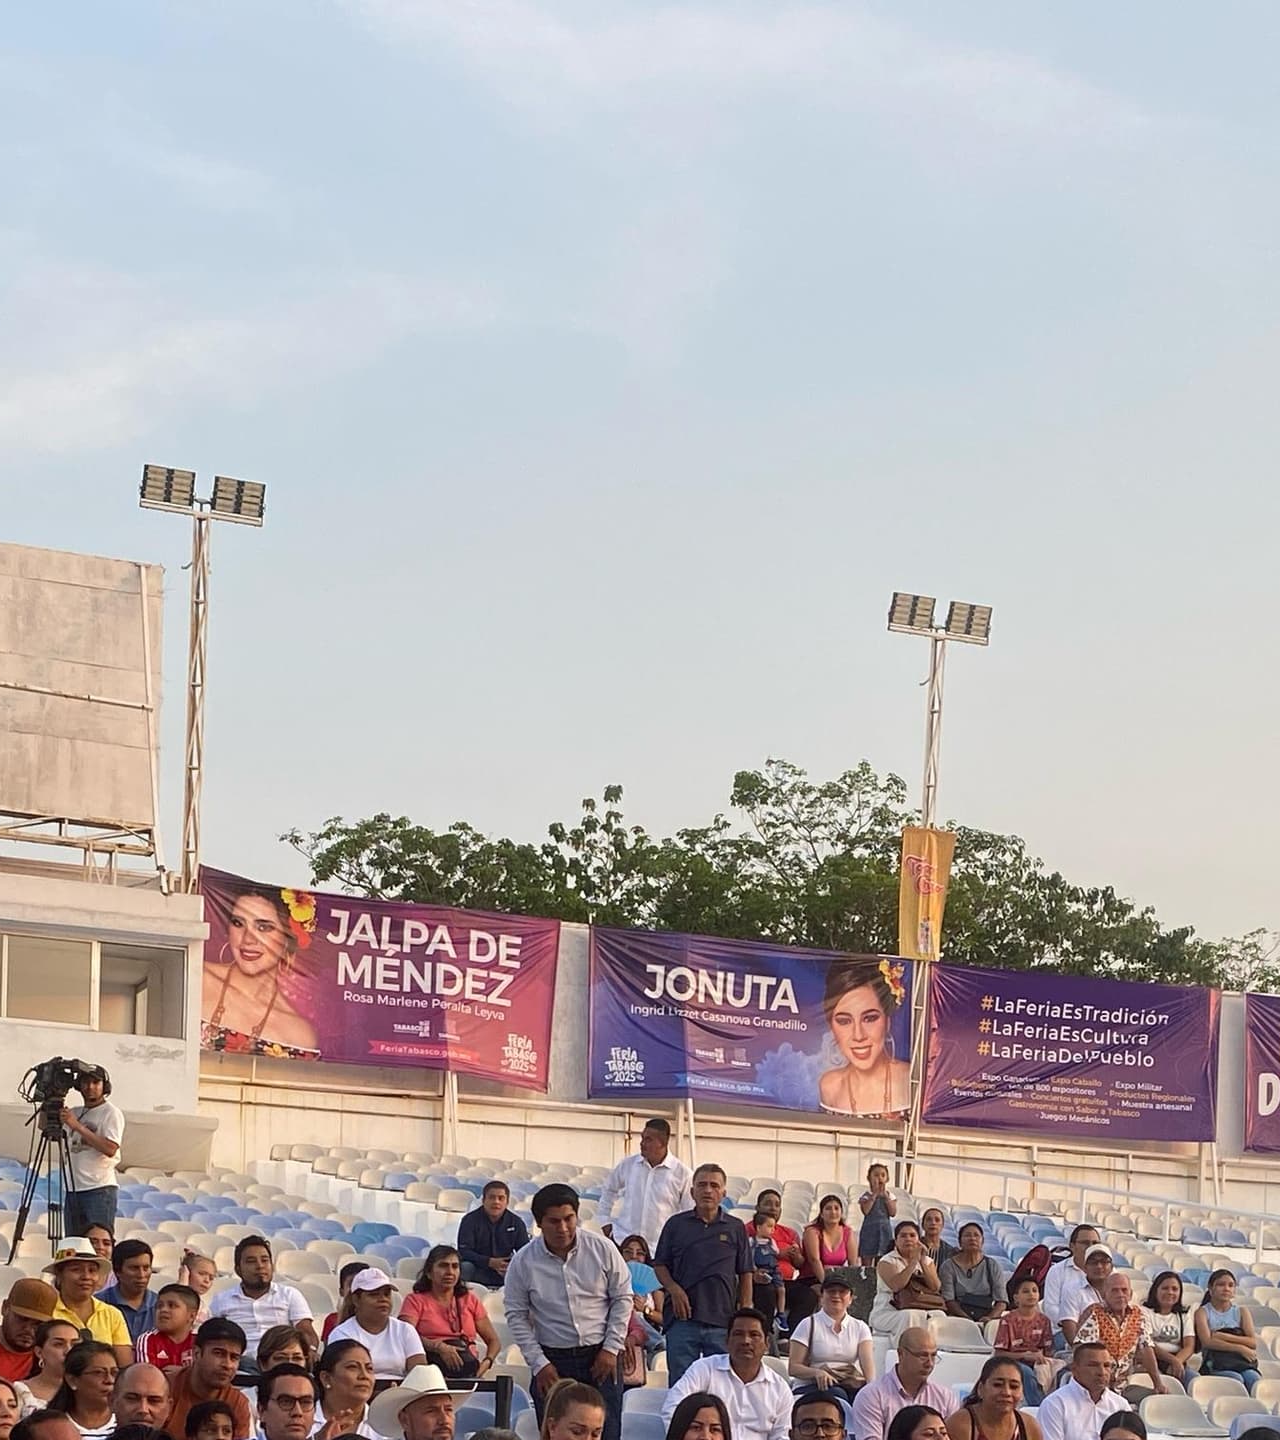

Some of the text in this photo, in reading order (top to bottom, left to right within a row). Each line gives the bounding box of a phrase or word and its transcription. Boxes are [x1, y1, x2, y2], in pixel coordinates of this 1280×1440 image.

[326, 908, 521, 969] JALPA DE
[336, 947, 514, 1008] MÉNDEZ
[644, 964, 799, 1014] JONUTA
[343, 990, 505, 1022] Rosa Marlene Peralta Leyva
[631, 1004, 807, 1032] Ingrid Lizzet Casanova Granadillo
[980, 994, 1169, 1027] #LaFeriaEsTradición
[978, 1018, 1149, 1046] #LaFeriaEsCultura
[509, 1059, 529, 1073] 2025
[611, 1046, 638, 1061] FERIA
[977, 1040, 1154, 1067] #LaFeriaDelPueblo
[613, 1072, 636, 1082] 2025
[1115, 1081, 1135, 1091] Expo
[1040, 1112, 1068, 1122] Juegos
